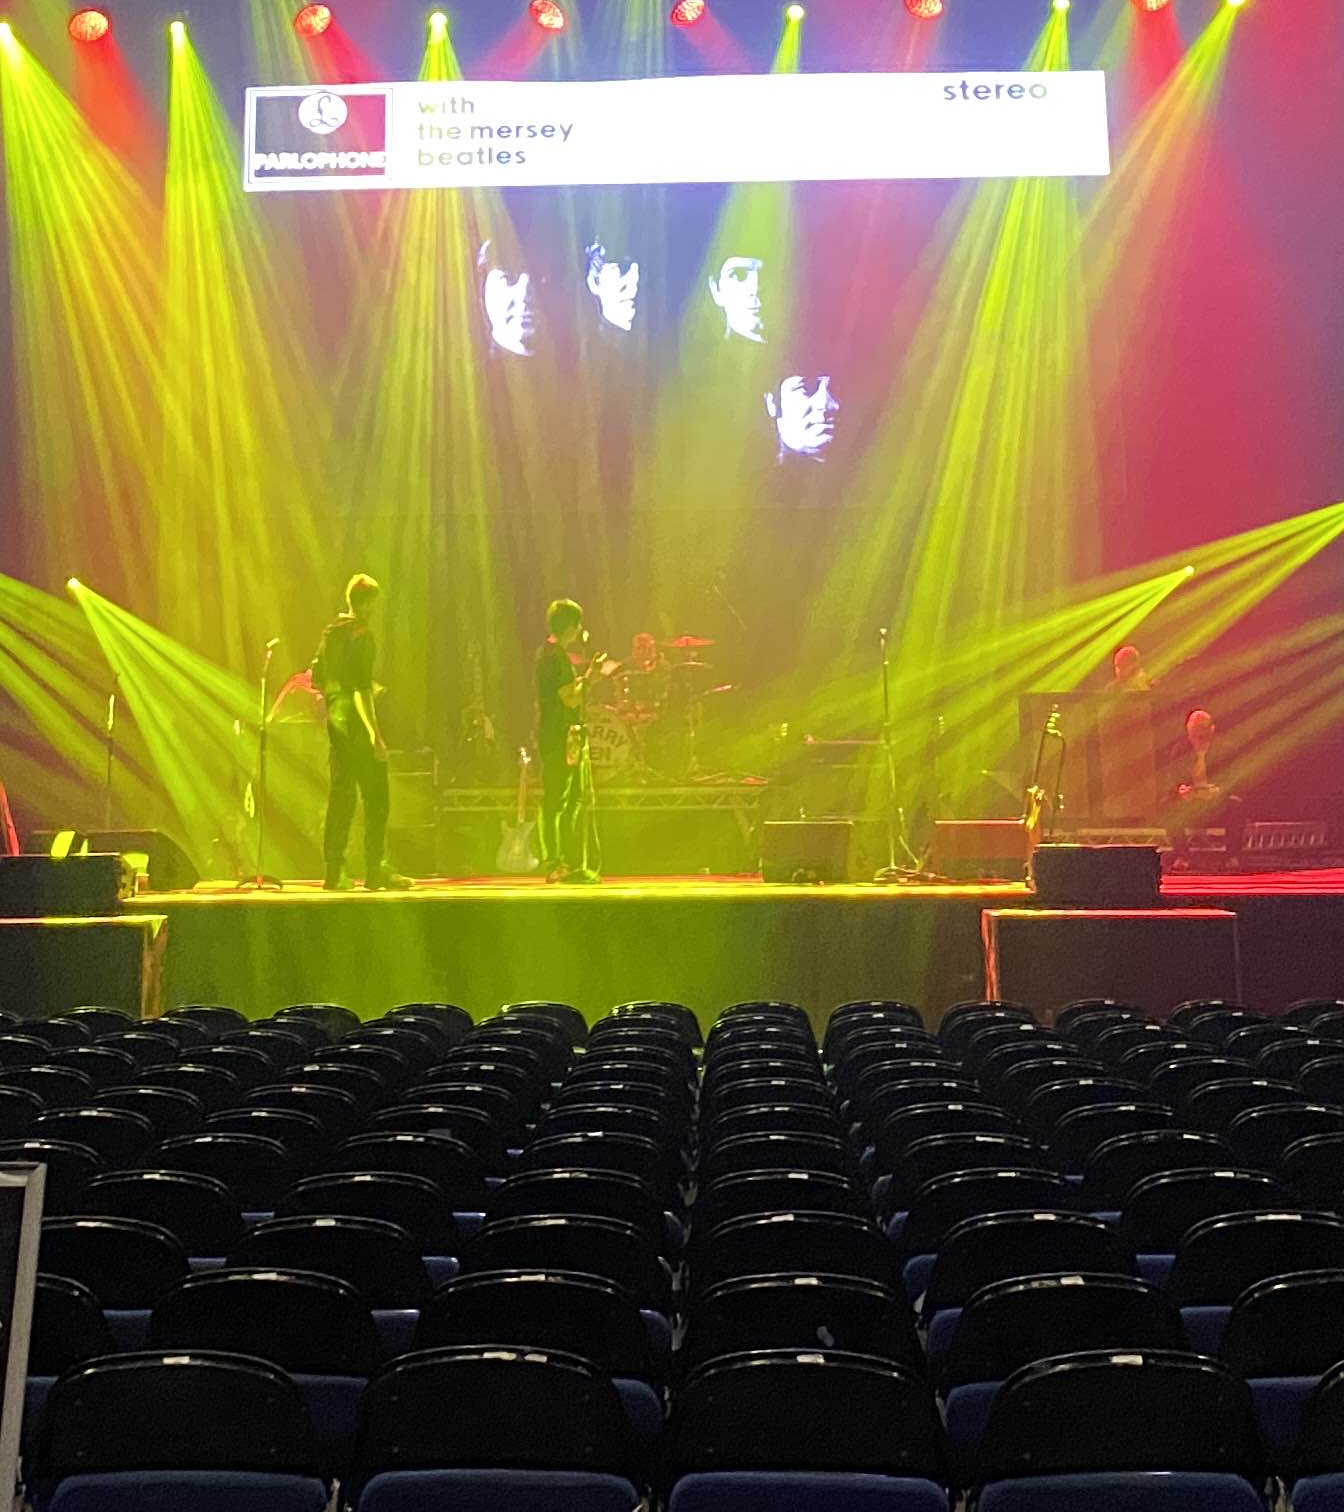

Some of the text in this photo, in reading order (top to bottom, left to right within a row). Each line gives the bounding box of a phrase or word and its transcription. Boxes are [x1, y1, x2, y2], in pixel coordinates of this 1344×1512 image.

[943, 80, 1047, 100] stereo
[418, 97, 474, 114] with
[418, 122, 573, 142] the mersey
[418, 147, 526, 165] beatles
